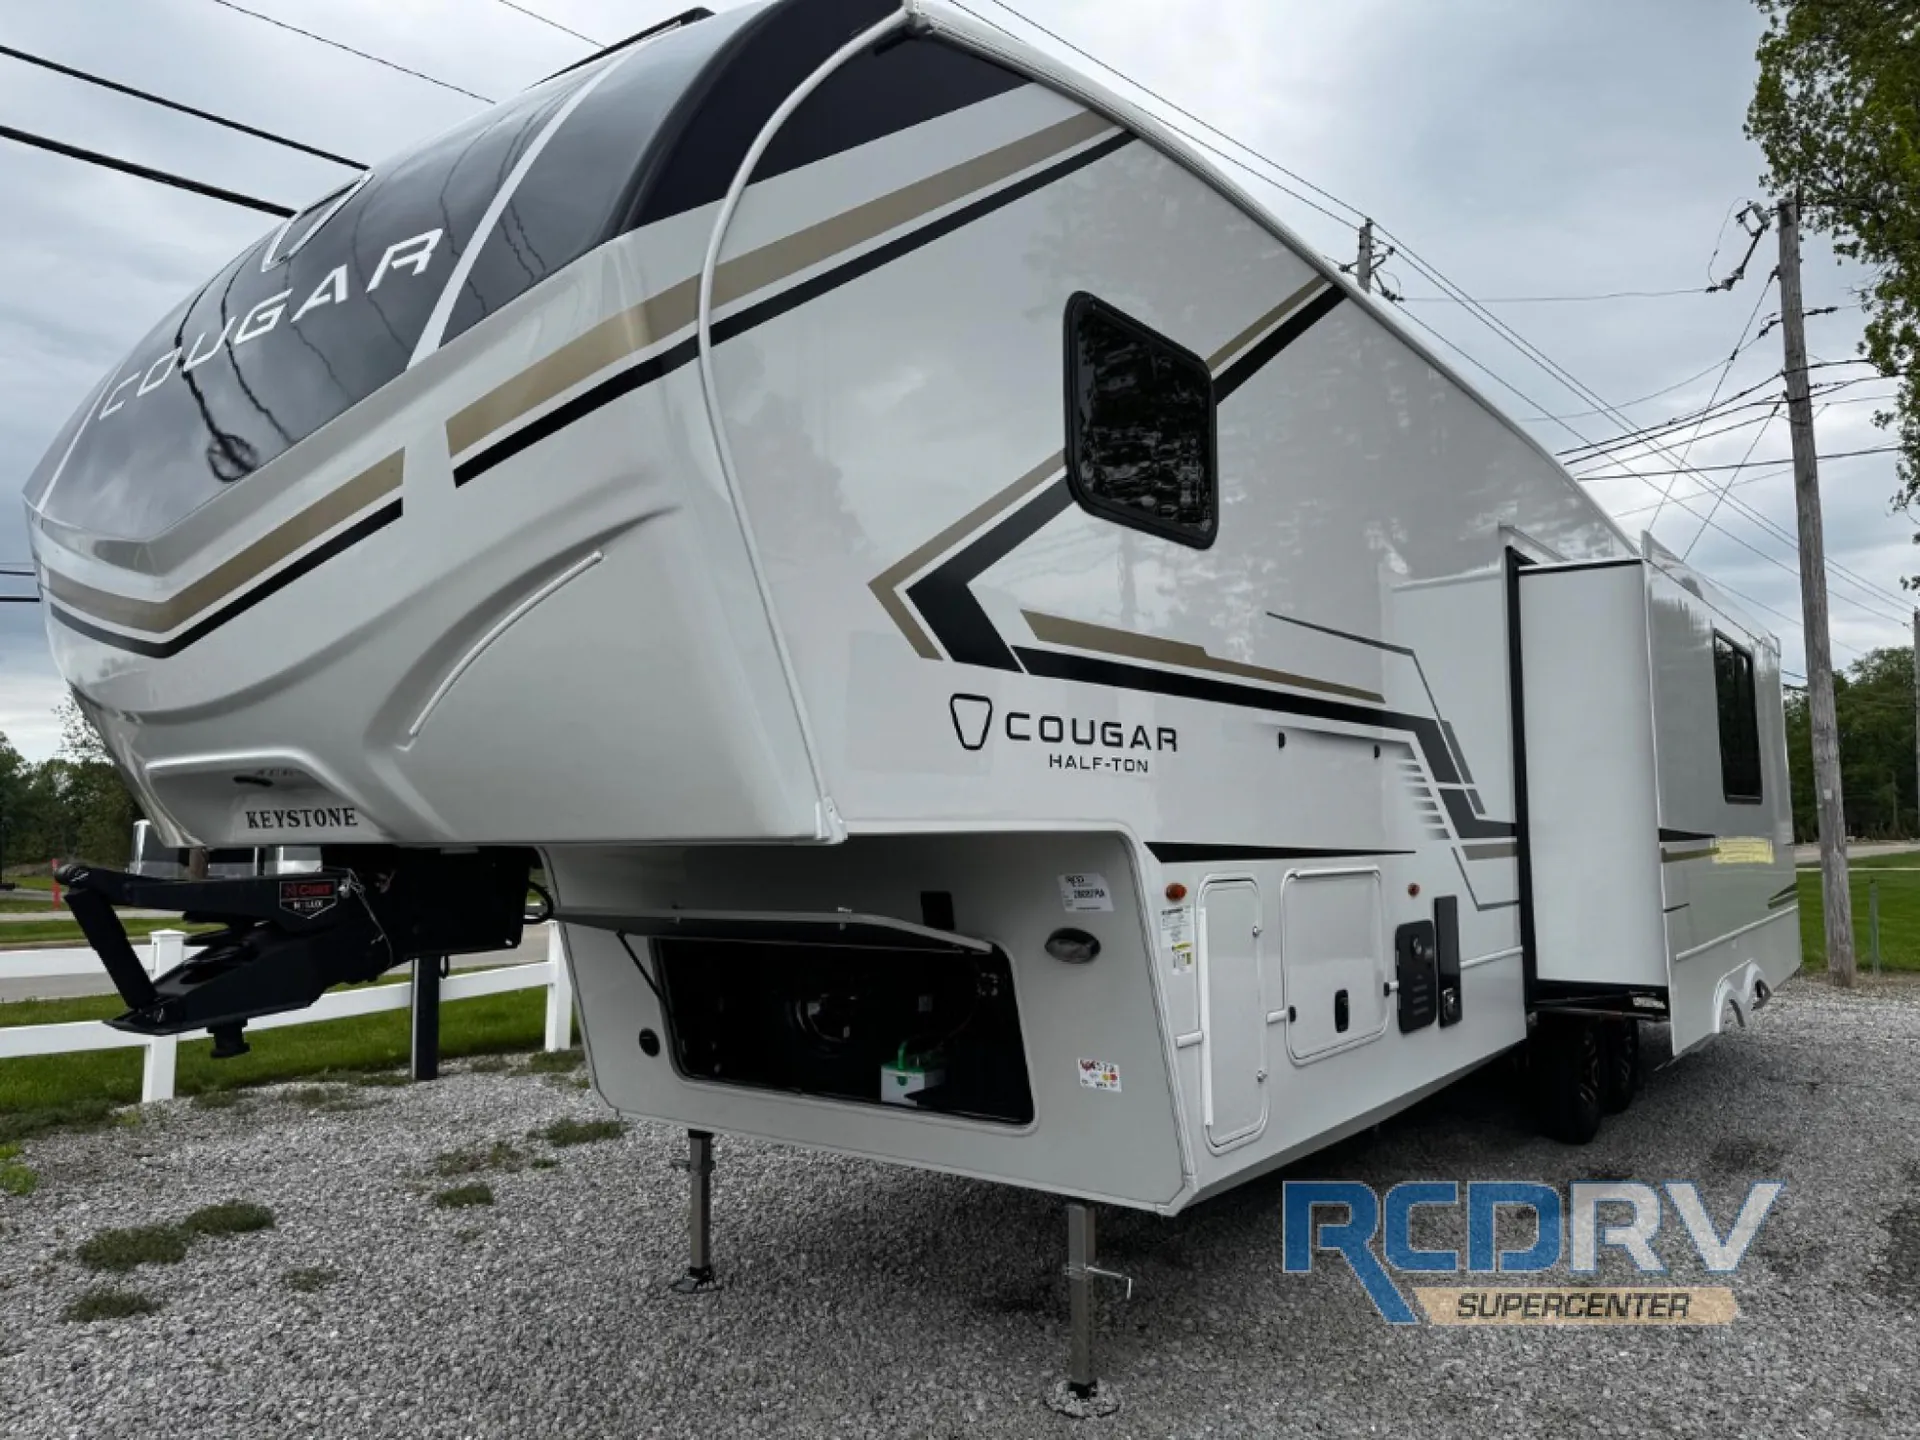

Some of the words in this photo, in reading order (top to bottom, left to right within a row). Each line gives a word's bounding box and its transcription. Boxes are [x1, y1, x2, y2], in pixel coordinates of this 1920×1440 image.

[99, 227, 444, 420] COUGAR
[1006, 712, 1178, 752] COUGAR
[1049, 754, 1149, 773] HALF-TON
[246, 807, 359, 829] KEYSTONE
